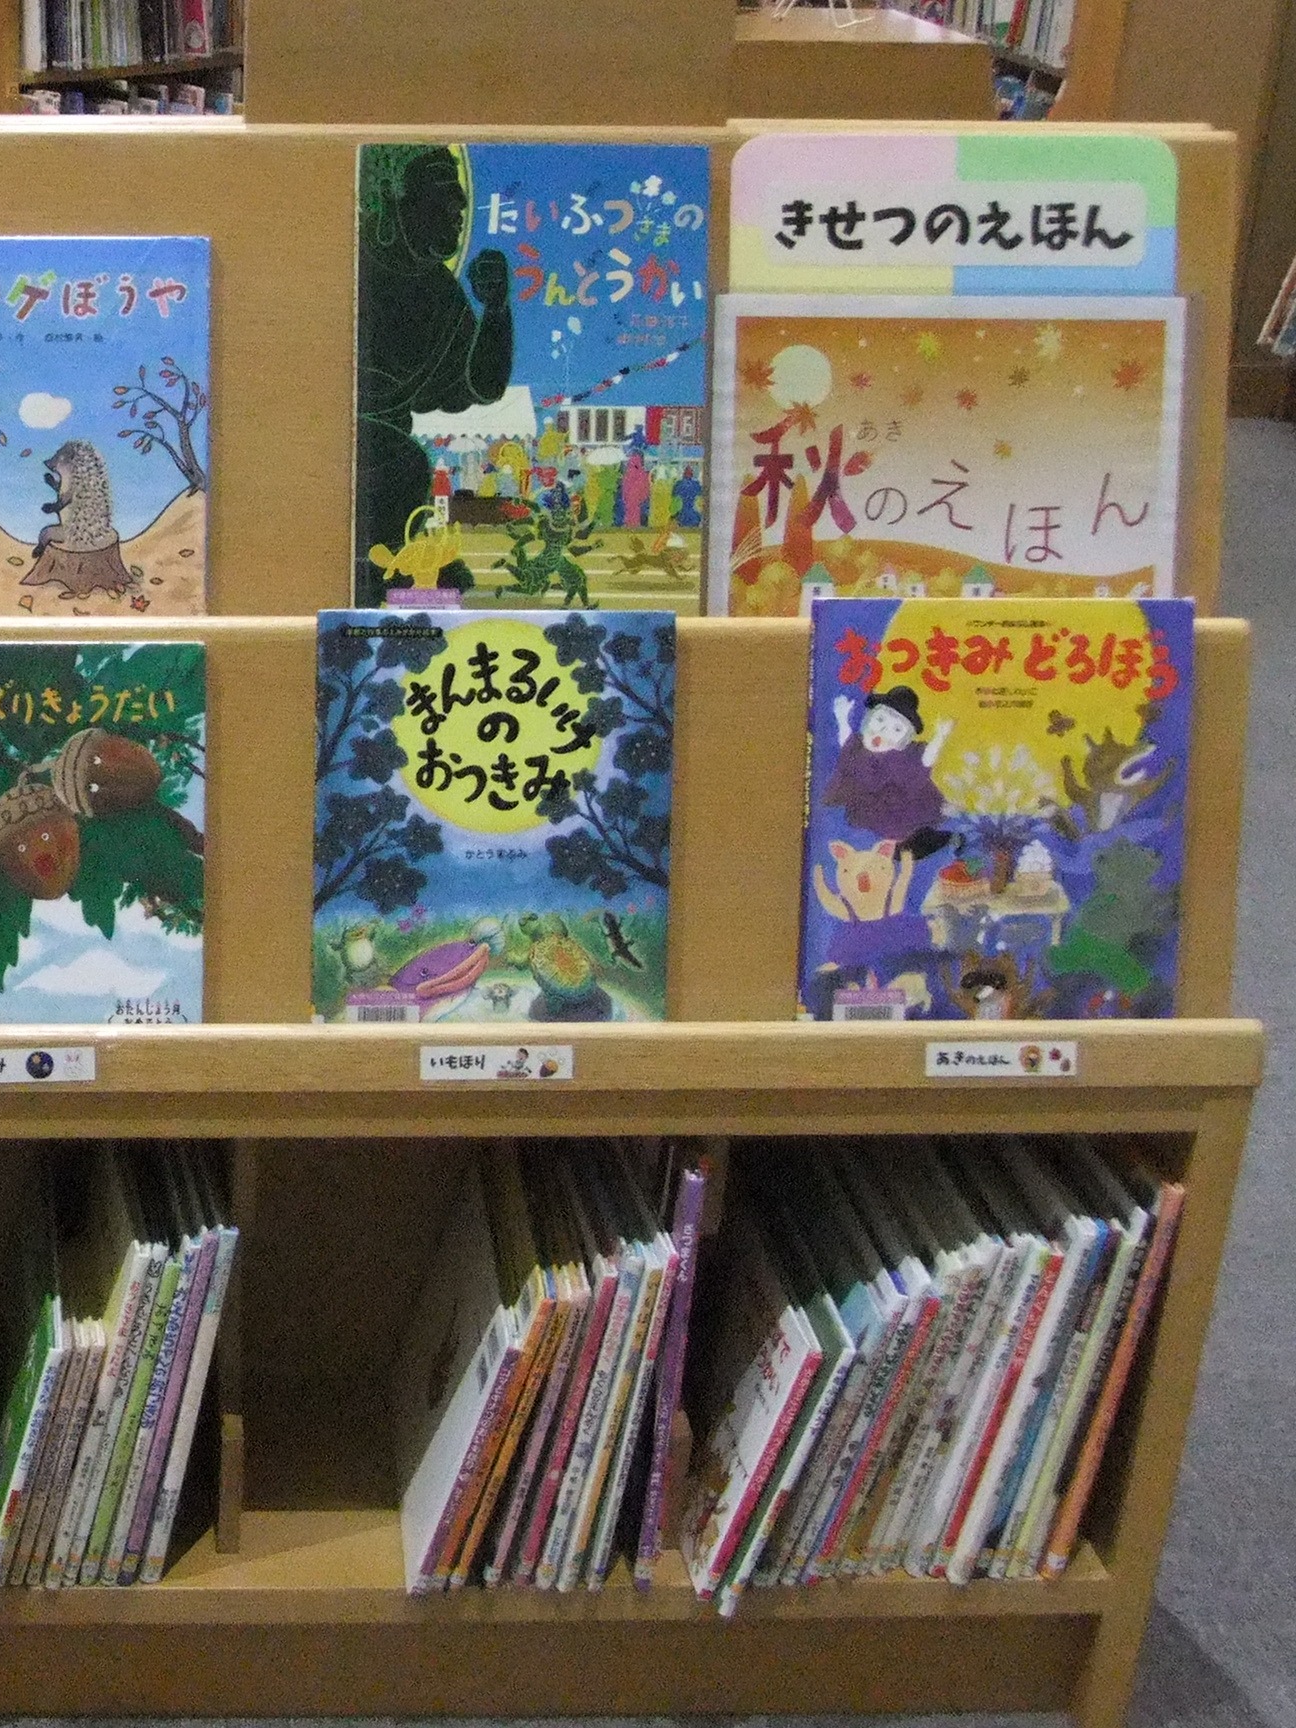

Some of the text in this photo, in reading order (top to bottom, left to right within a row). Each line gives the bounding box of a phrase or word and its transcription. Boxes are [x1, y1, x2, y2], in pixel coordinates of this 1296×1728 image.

[774, 199, 1134, 250] きせつのえほん
[855, 419, 903, 442] あき
[741, 412, 1149, 564] 秋のえほん
[477, 712, 519, 743] の
[416, 738, 571, 811] おつきみ
[430, 1054, 487, 1071] いもほり
[936, 1050, 1012, 1067] あきのえほん
